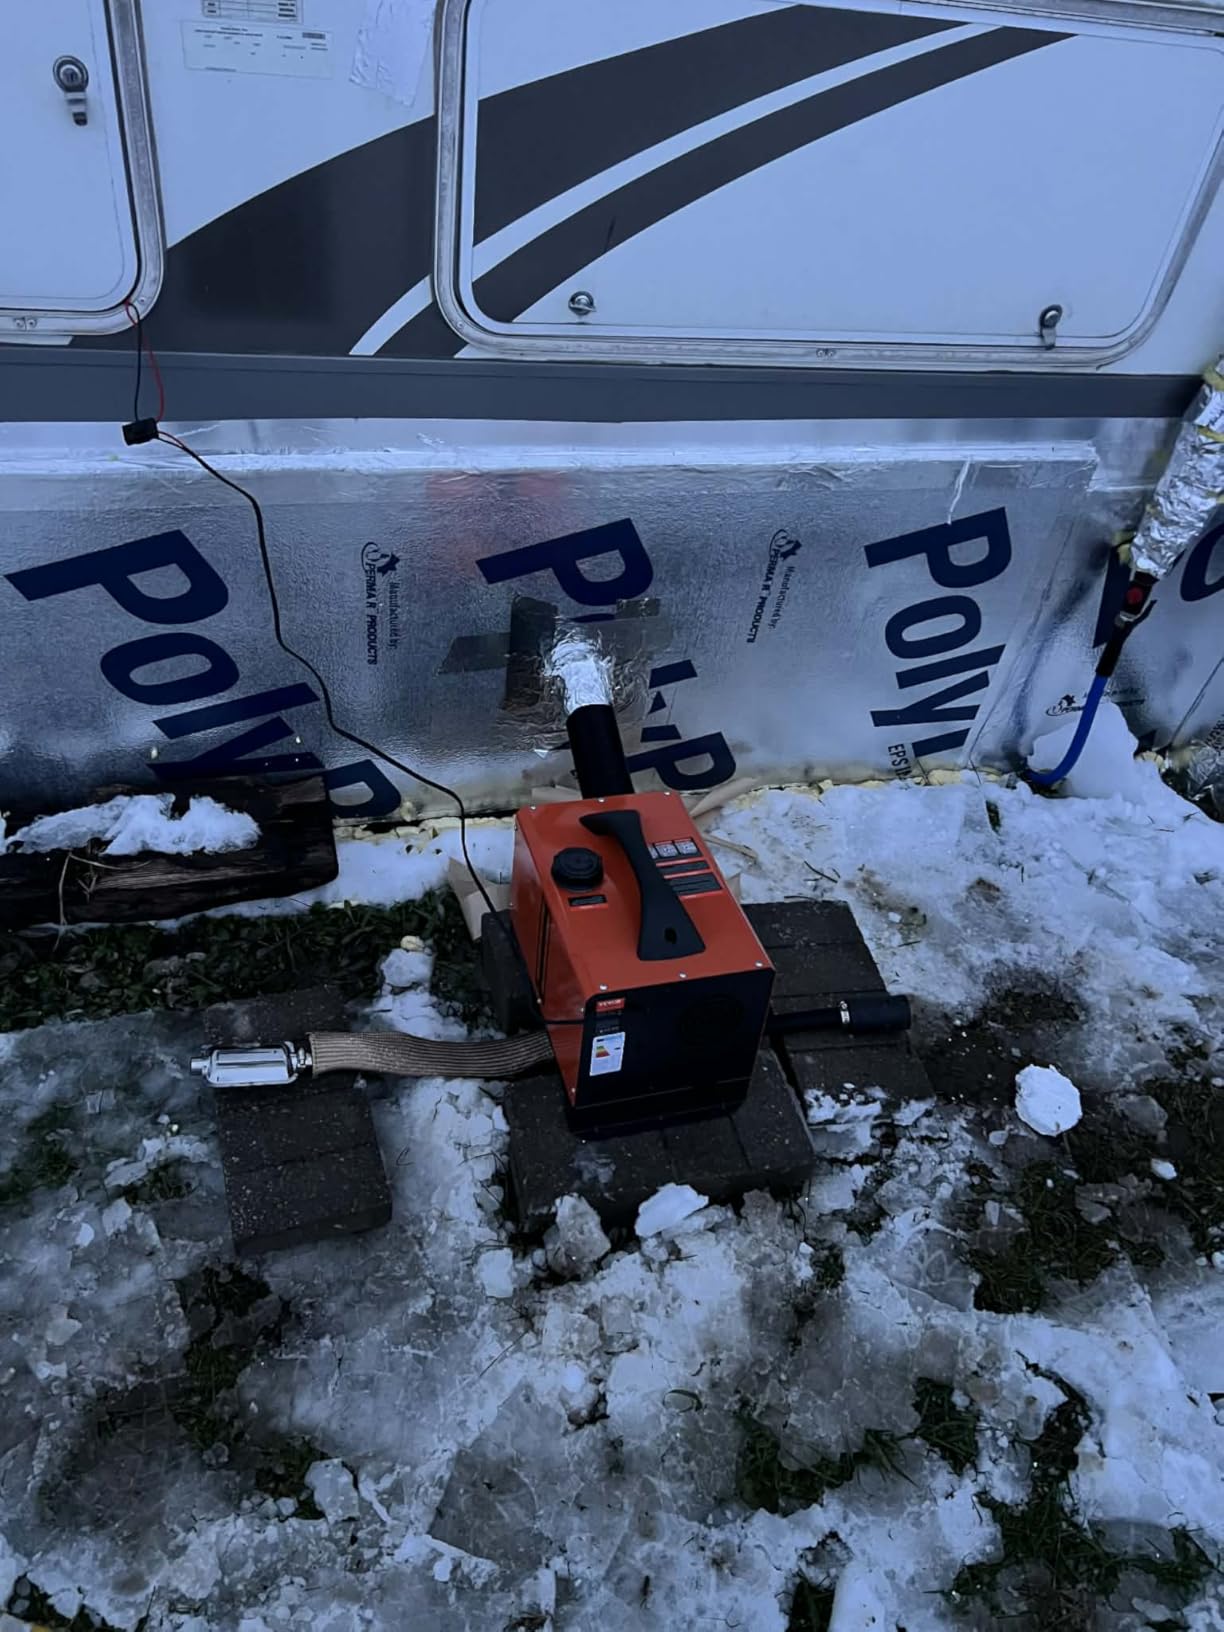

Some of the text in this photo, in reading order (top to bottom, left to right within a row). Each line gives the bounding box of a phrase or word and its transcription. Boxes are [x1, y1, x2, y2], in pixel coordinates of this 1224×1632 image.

[366, 563, 376, 599] PERMA
[765, 549, 779, 582] PERMA
[747, 596, 767, 642] PRODUCTS
[367, 614, 377, 665] PRODUCTS
[887, 743, 909, 767] EPS
